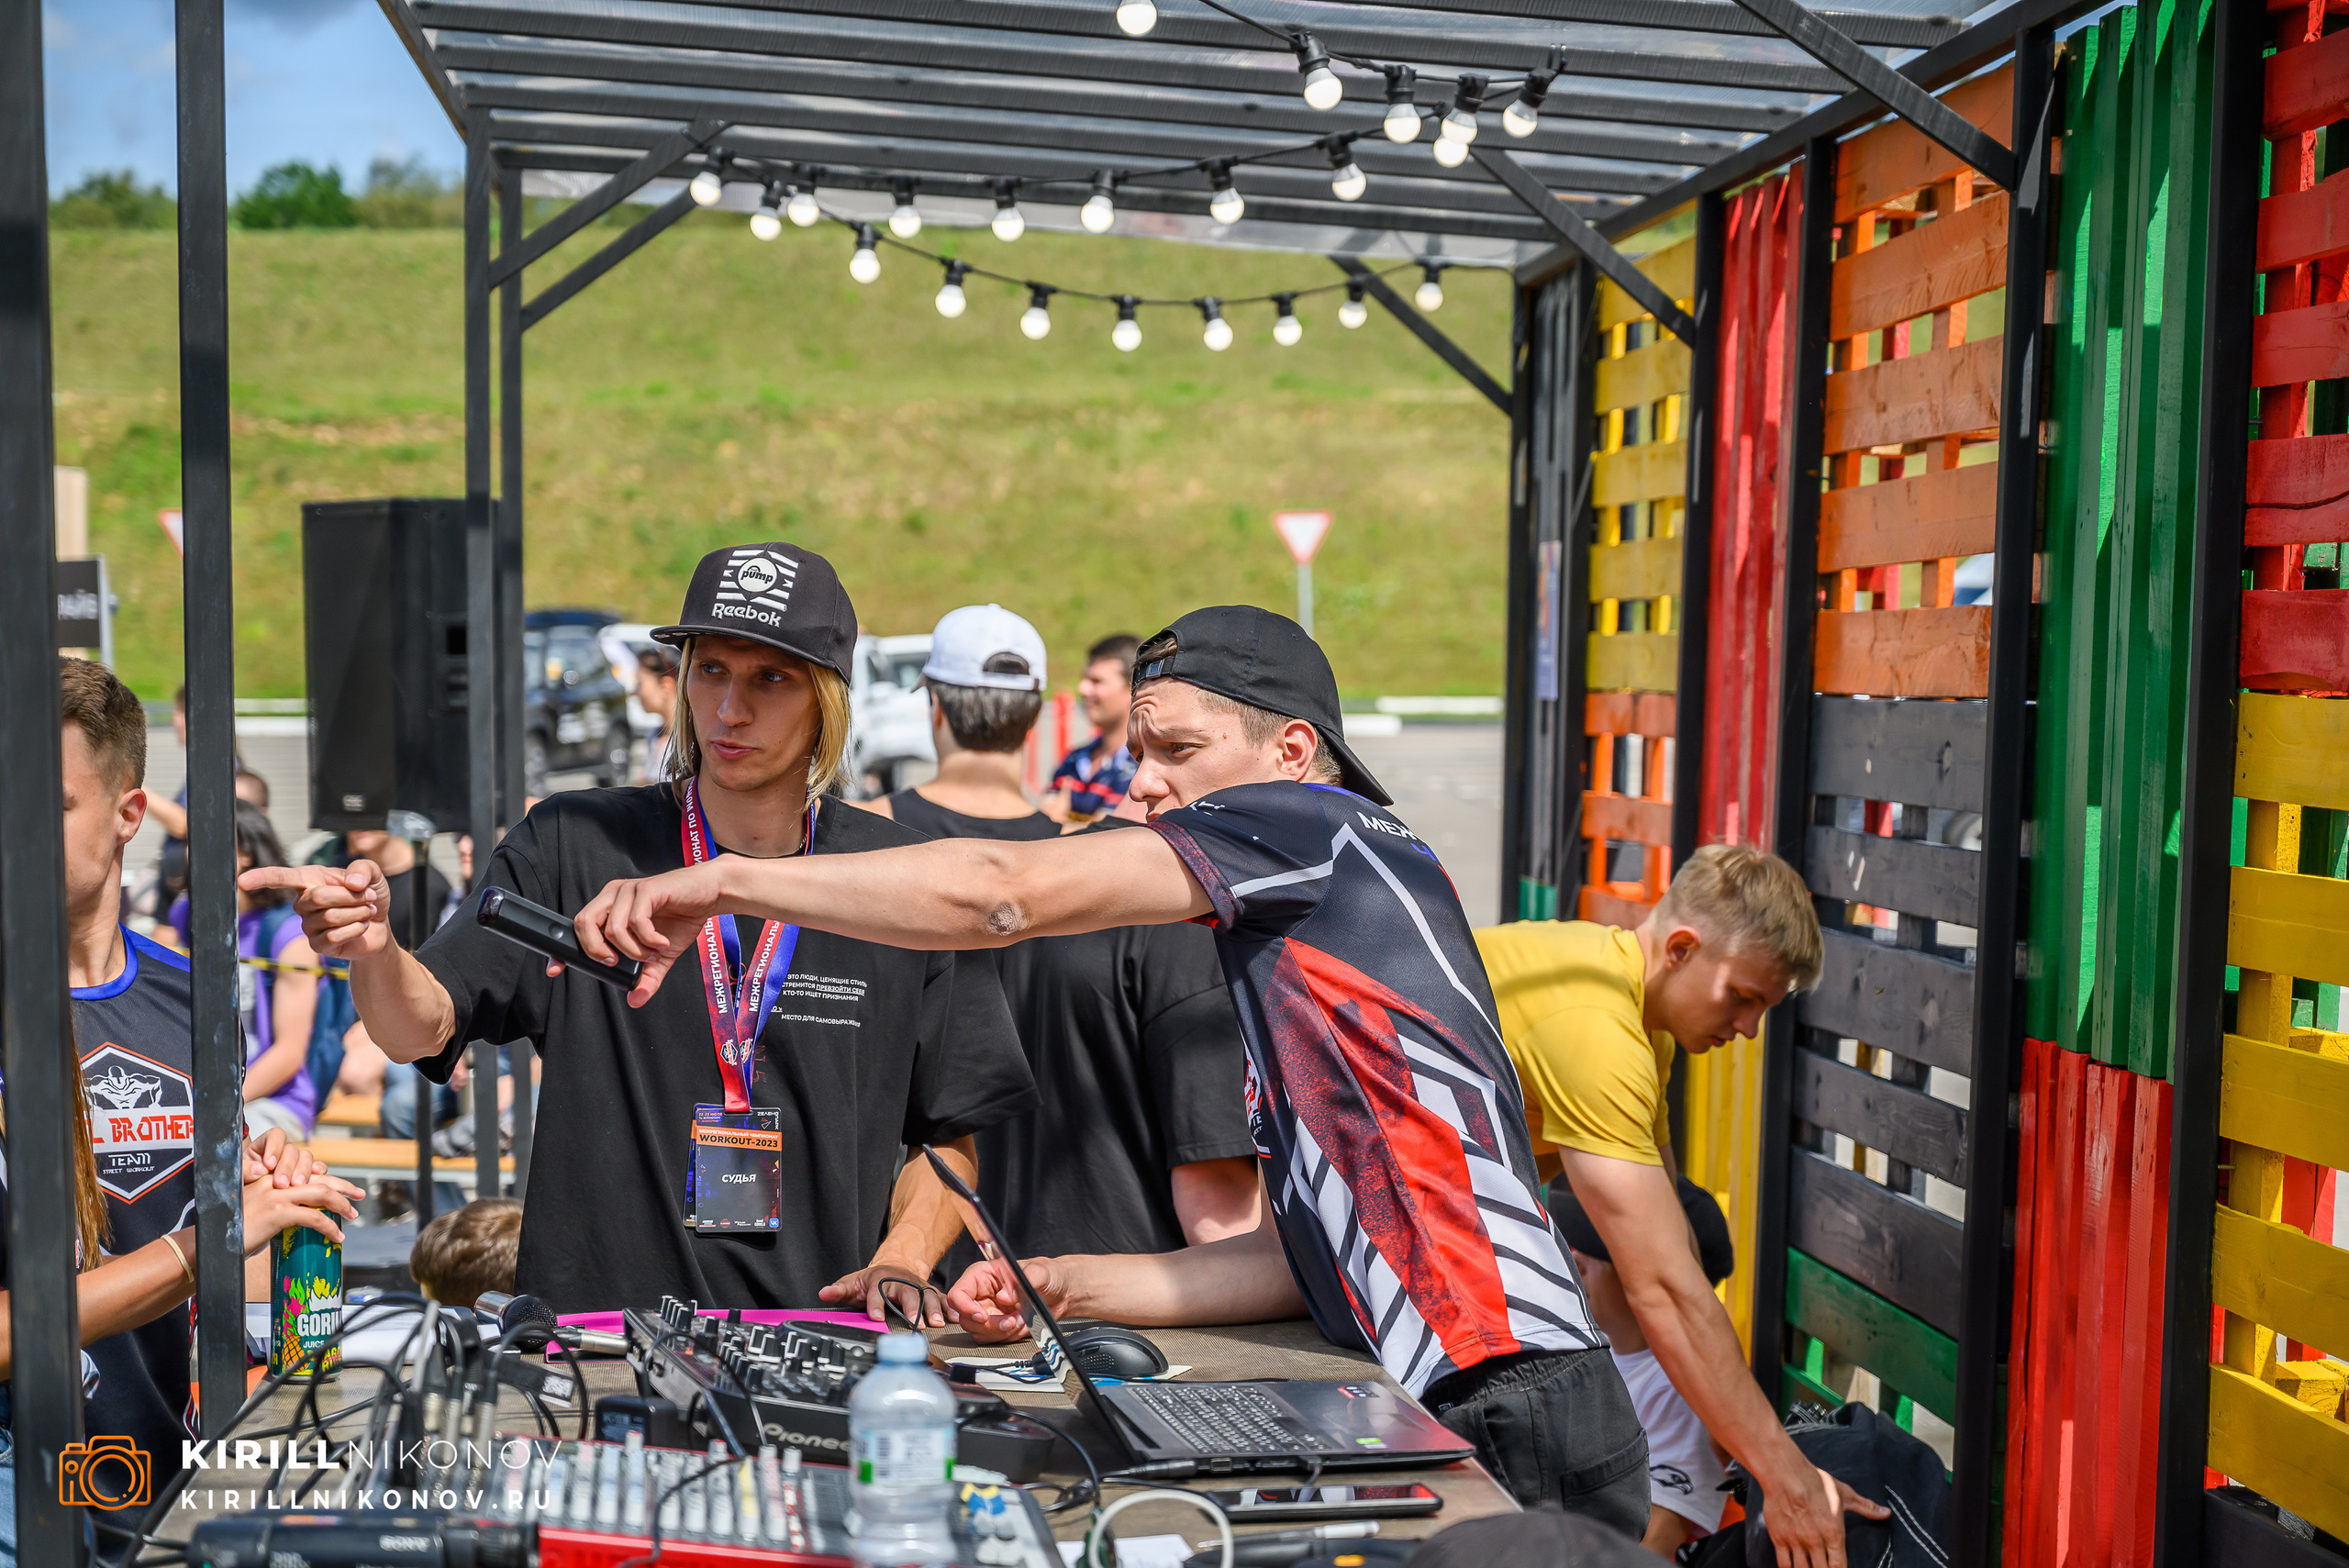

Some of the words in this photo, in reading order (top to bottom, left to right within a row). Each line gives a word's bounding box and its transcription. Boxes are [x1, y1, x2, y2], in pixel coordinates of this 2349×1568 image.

[740, 570, 774, 584] pump
[711, 603, 782, 628] Reebok
[687, 812, 697, 828] ПО
[705, 917, 729, 1014] МЕЖРЕГИОНАЛЬ
[749, 920, 780, 1012] МЕЖРЕГИОНАЛЬ
[799, 974, 819, 983] ЛЮДИ,
[822, 994, 859, 1002] ПРИЗНАНИЯ
[107, 1114, 195, 1143] BROTHER
[699, 1134, 778, 1148] WORKOUT-2023
[108, 1152, 151, 1167] TEAM
[127, 1165, 155, 1173] WORKOUT
[721, 1173, 756, 1184] СУДЬЯ
[755, 1422, 852, 1451] Pionee
